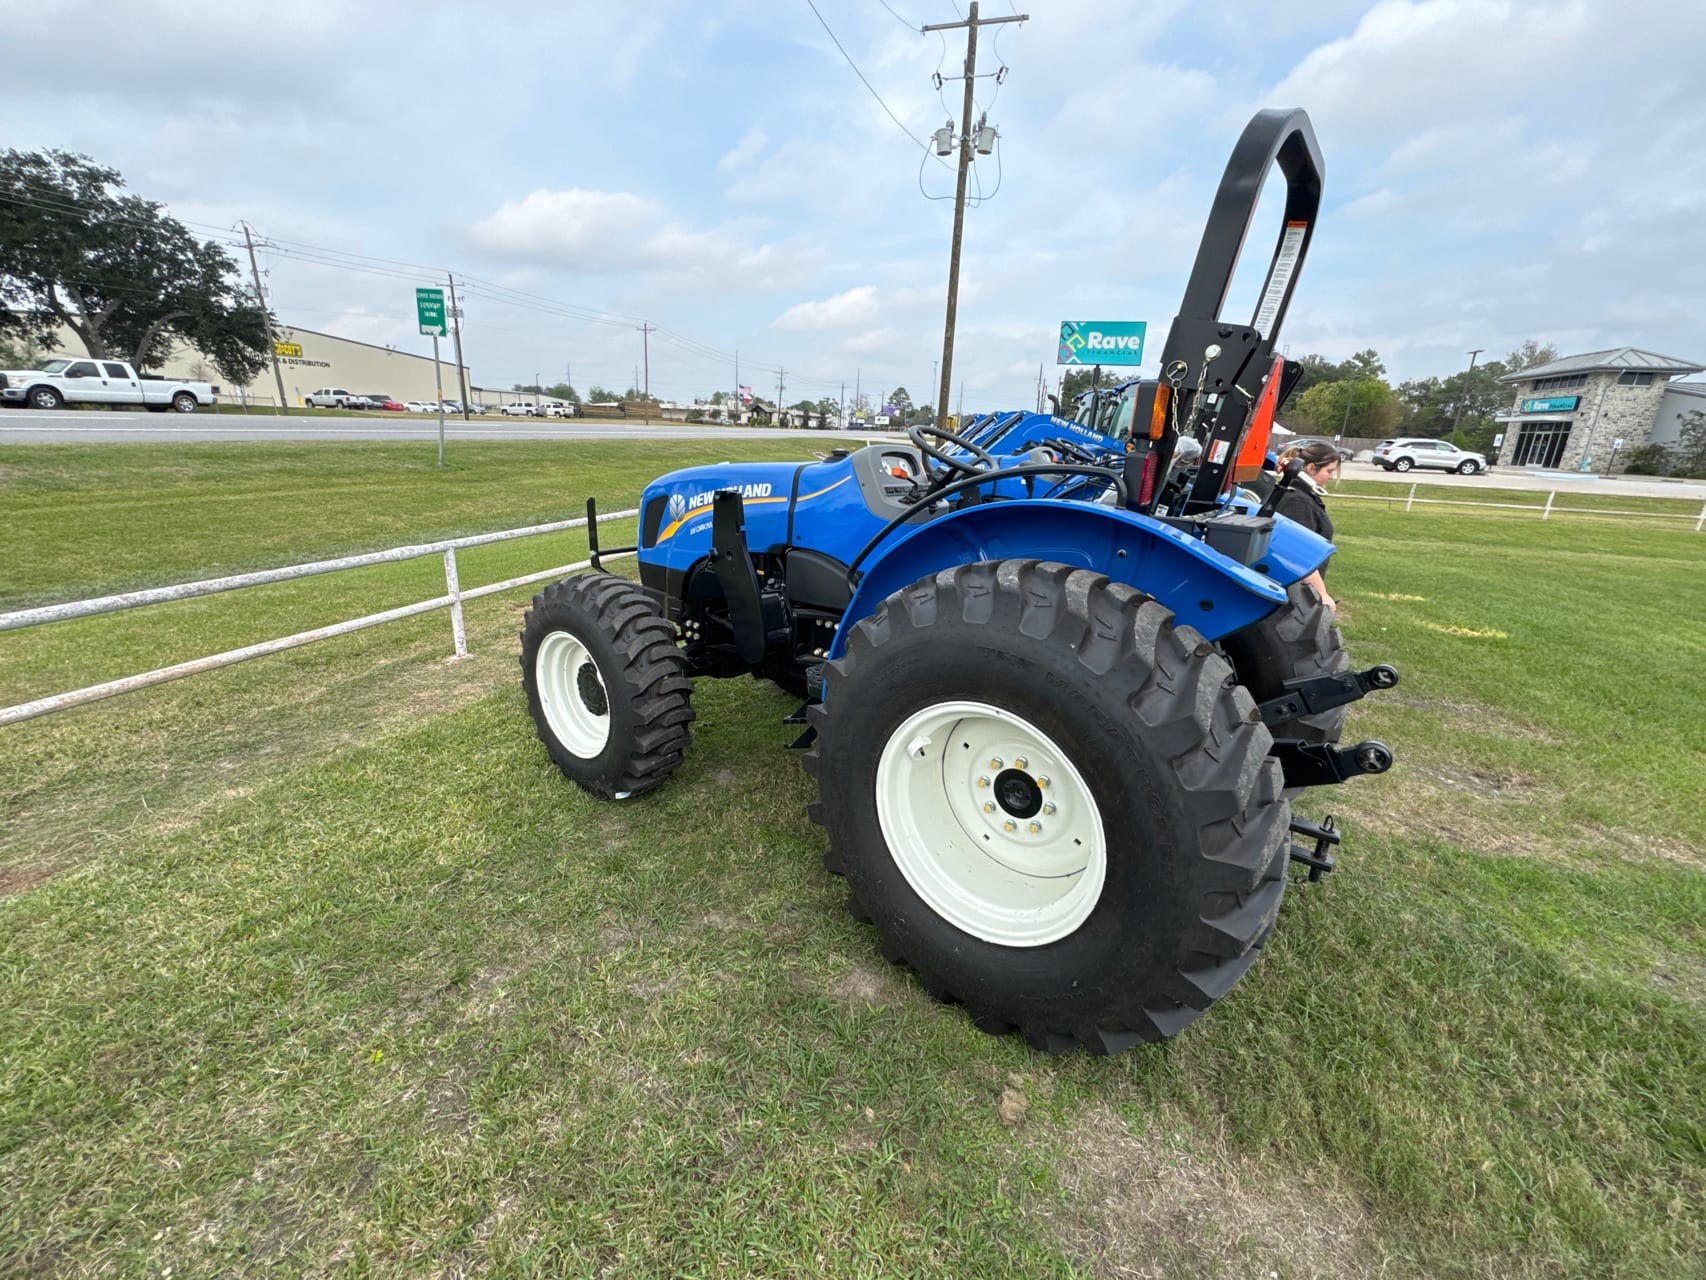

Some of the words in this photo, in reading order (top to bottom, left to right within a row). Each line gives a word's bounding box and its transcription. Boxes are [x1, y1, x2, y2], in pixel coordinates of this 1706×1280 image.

[1087, 331, 1140, 350] Rave
[288, 359, 331, 368] DISTRIBUTION
[1051, 416, 1069, 428] NEW
[1069, 423, 1104, 442] HOLLAND
[689, 490, 715, 510] NEW
[717, 483, 772, 498] LAND
